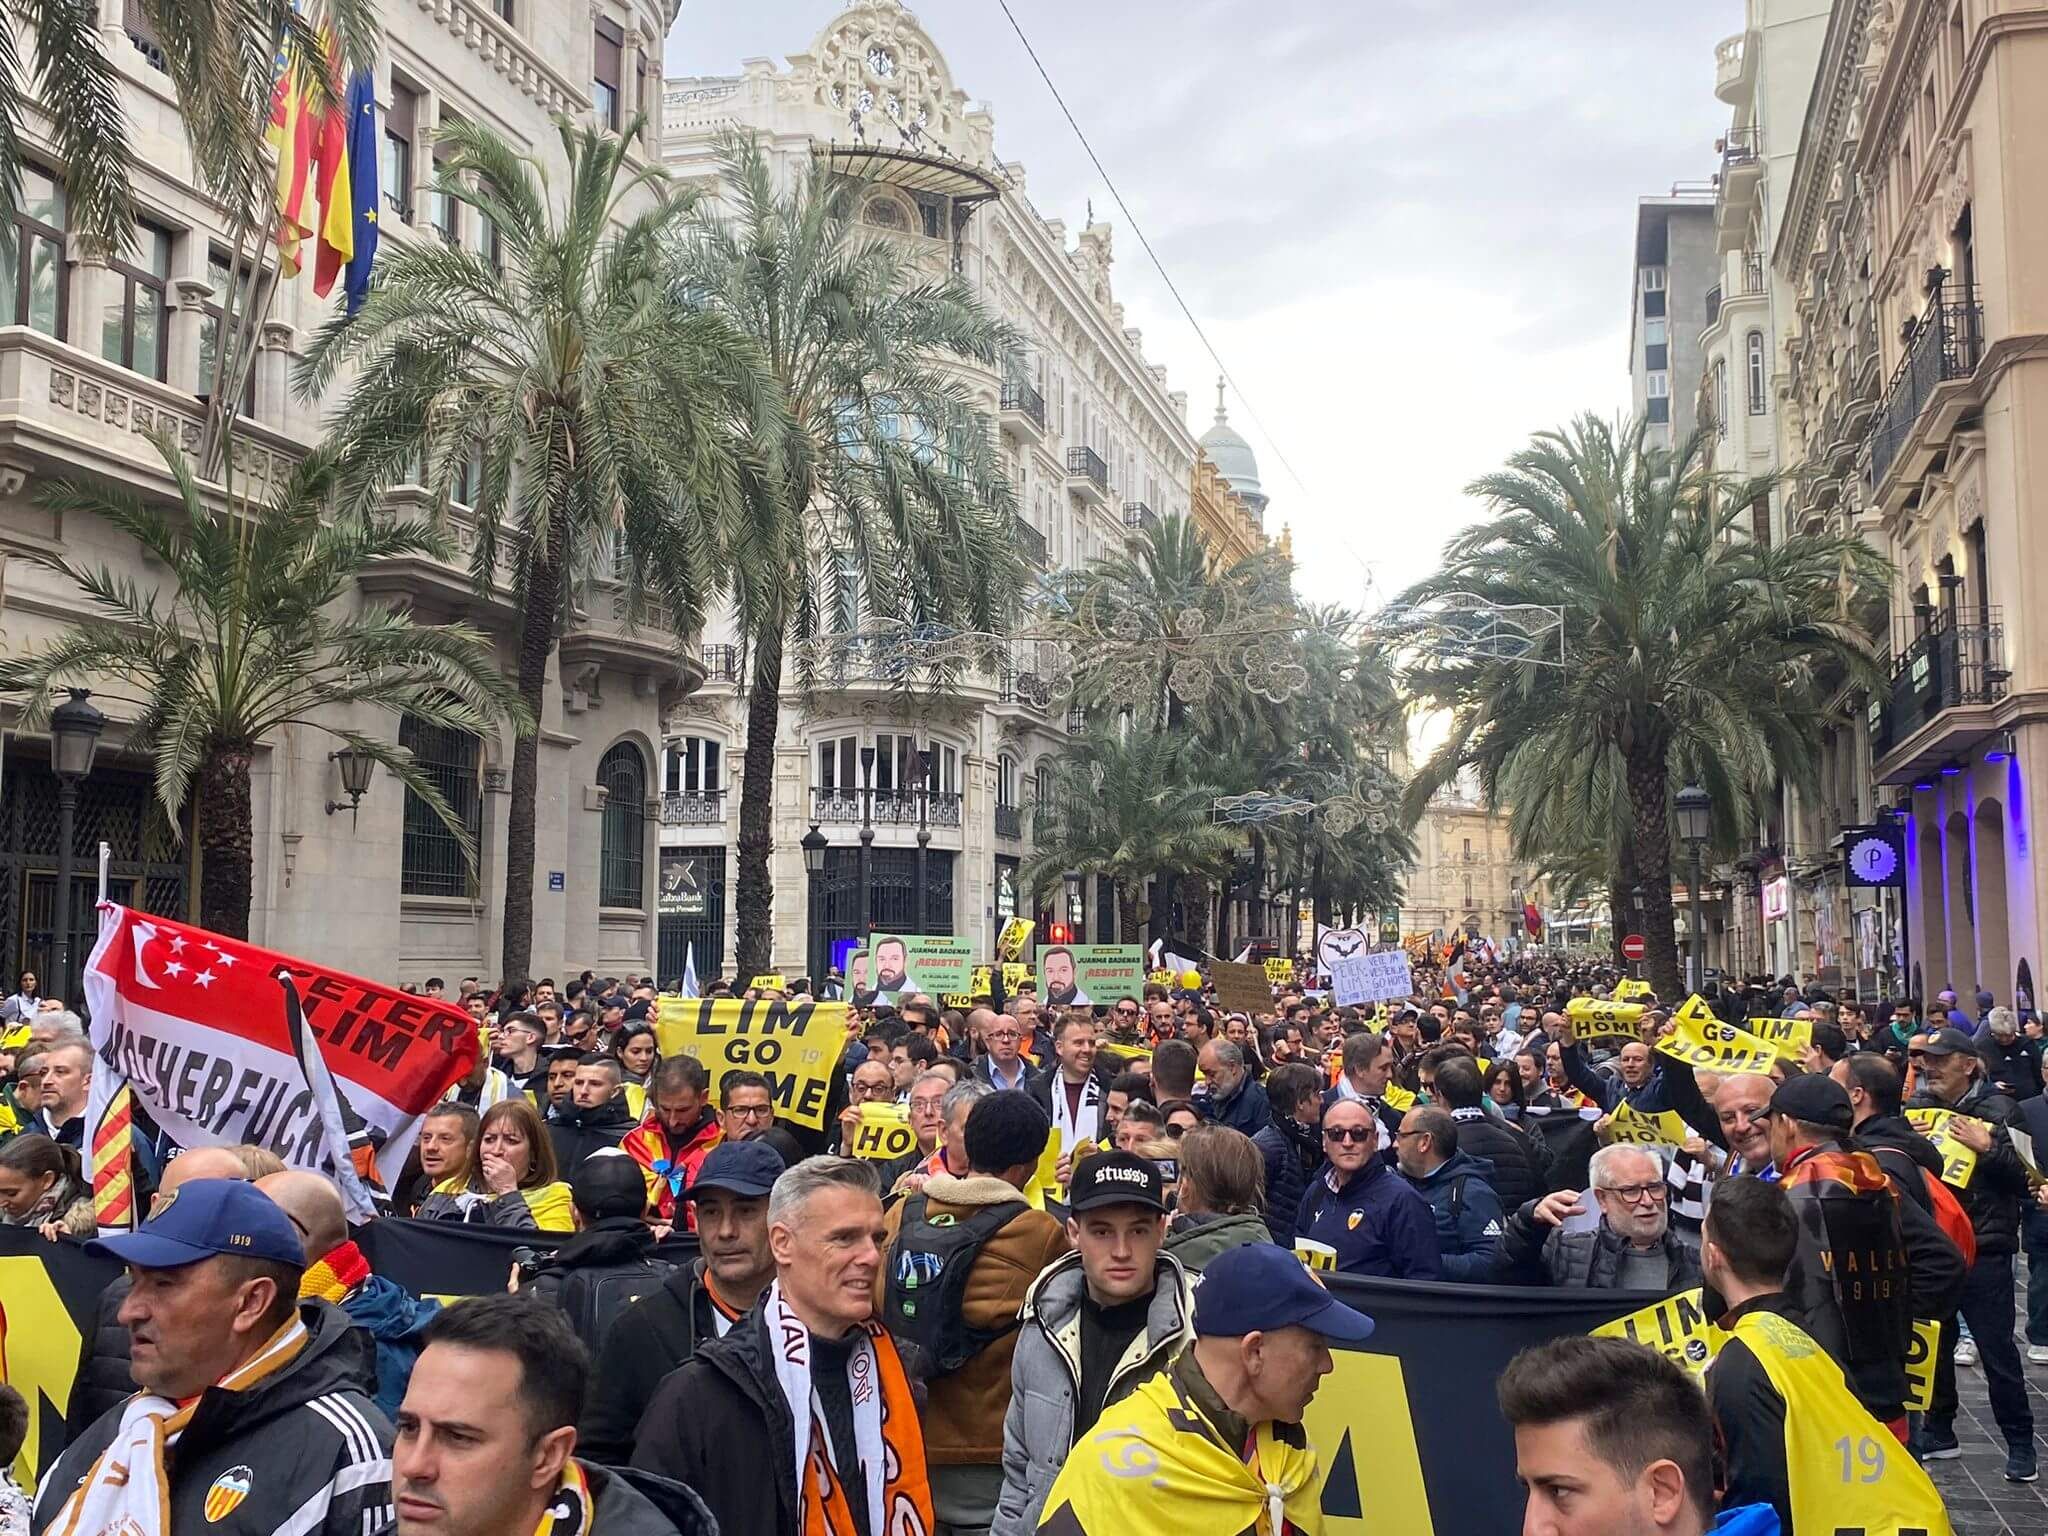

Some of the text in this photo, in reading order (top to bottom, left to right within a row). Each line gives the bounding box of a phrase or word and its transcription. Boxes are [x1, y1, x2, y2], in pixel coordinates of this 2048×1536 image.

[1266, 960, 1285, 968] LIM
[696, 999, 816, 1037] LIM
[301, 994, 414, 1072] LIM
[724, 1038, 782, 1065] GO
[1661, 1040, 1771, 1070] HOME
[857, 1126, 910, 1153] HO
[230, 1234, 251, 1246] 1919
